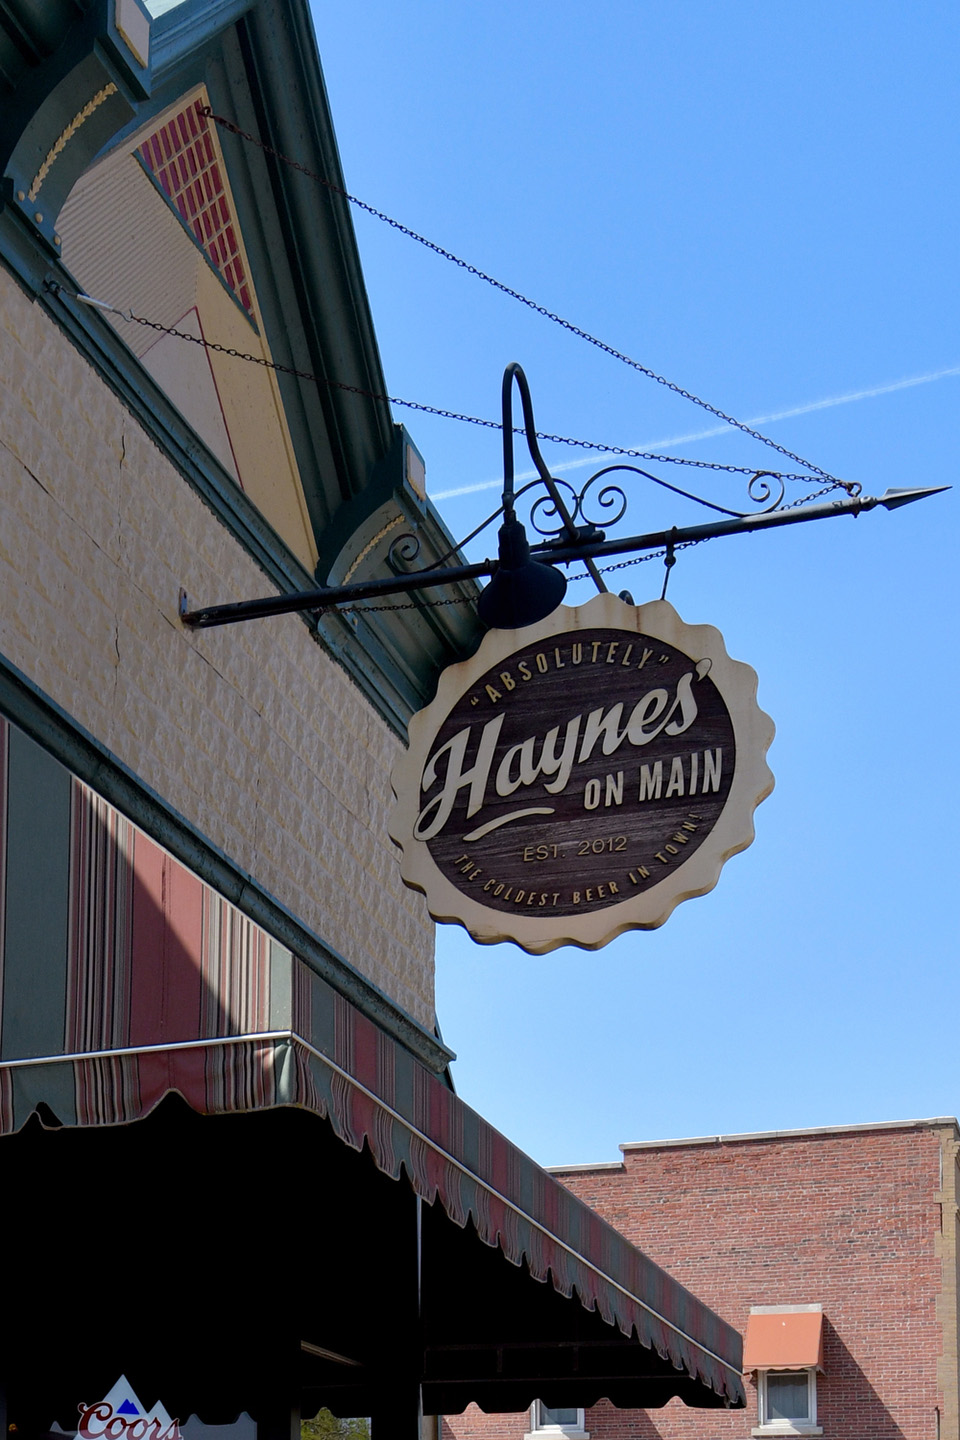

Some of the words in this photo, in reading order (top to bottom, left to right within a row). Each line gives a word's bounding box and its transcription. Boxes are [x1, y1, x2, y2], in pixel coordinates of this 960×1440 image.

[583, 770, 625, 811] ON
[638, 747, 723, 802] MAIN
[454, 853, 483, 882] THE
[483, 878, 560, 907] COLDEST
[572, 881, 620, 905] BEER
[628, 864, 651, 885] IN
[654, 812, 703, 865] TOWN!
[522, 844, 566, 863] EST.
[577, 836, 628, 857] 2012
